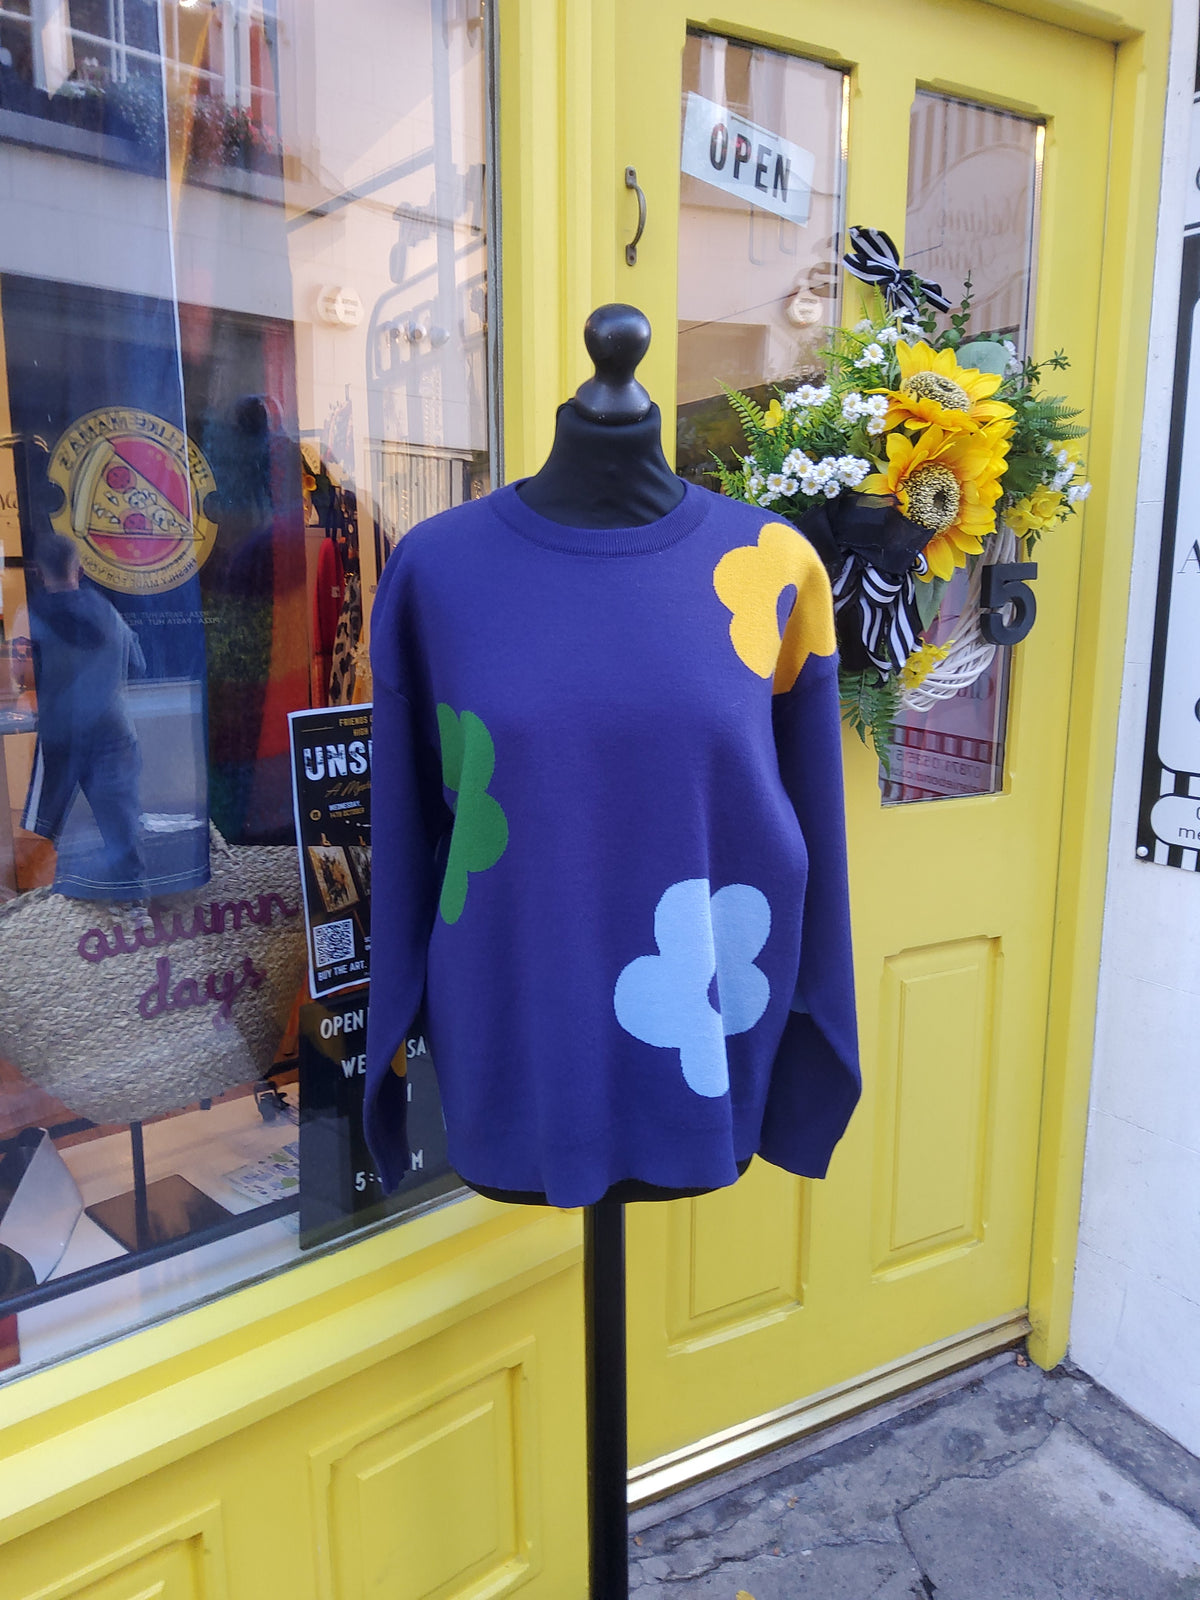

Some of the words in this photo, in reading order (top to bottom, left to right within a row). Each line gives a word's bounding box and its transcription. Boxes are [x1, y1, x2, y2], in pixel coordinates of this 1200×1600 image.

[709, 123, 791, 203] OPEN
[980, 561, 1038, 646] 5
[77, 892, 300, 963] autumn
[137, 956, 268, 1032] days
[317, 969, 332, 981] BUY
[334, 963, 348, 976] THE
[320, 1009, 364, 1040] OPEN
